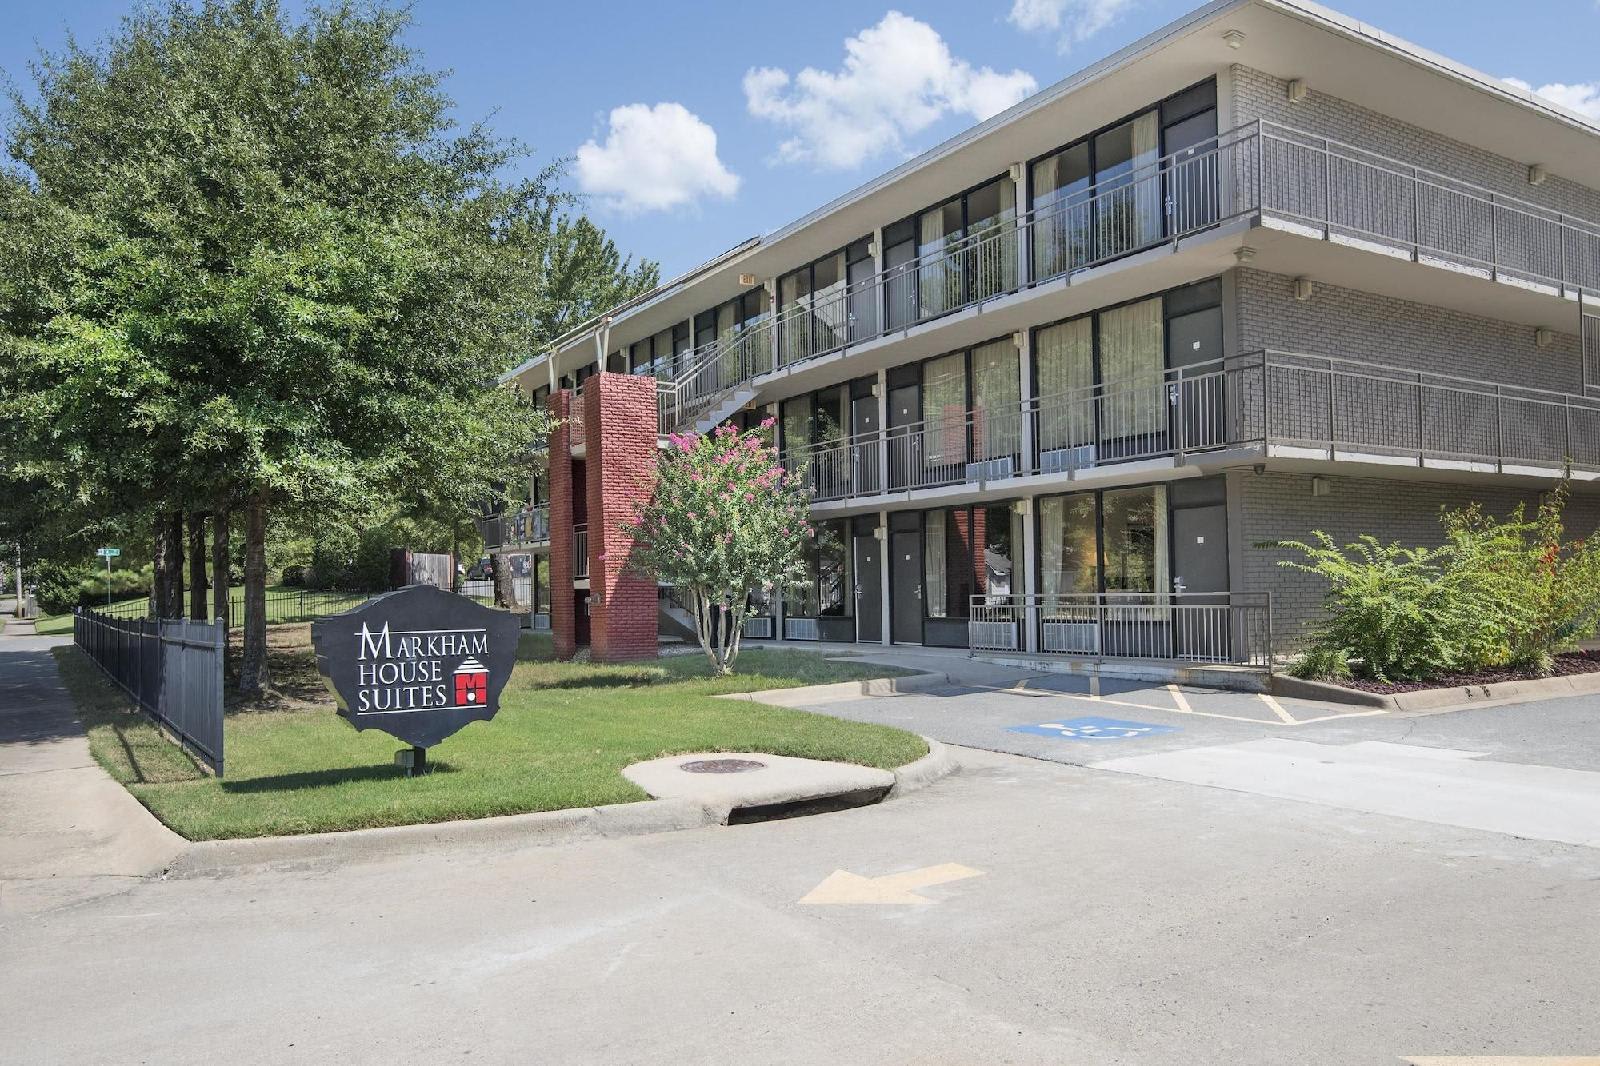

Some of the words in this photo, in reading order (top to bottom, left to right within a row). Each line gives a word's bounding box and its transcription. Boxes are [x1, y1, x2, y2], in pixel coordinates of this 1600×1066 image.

[357, 620, 489, 661] MARKHAM
[358, 660, 443, 686] HOUSE
[358, 684, 447, 712] SUITES
